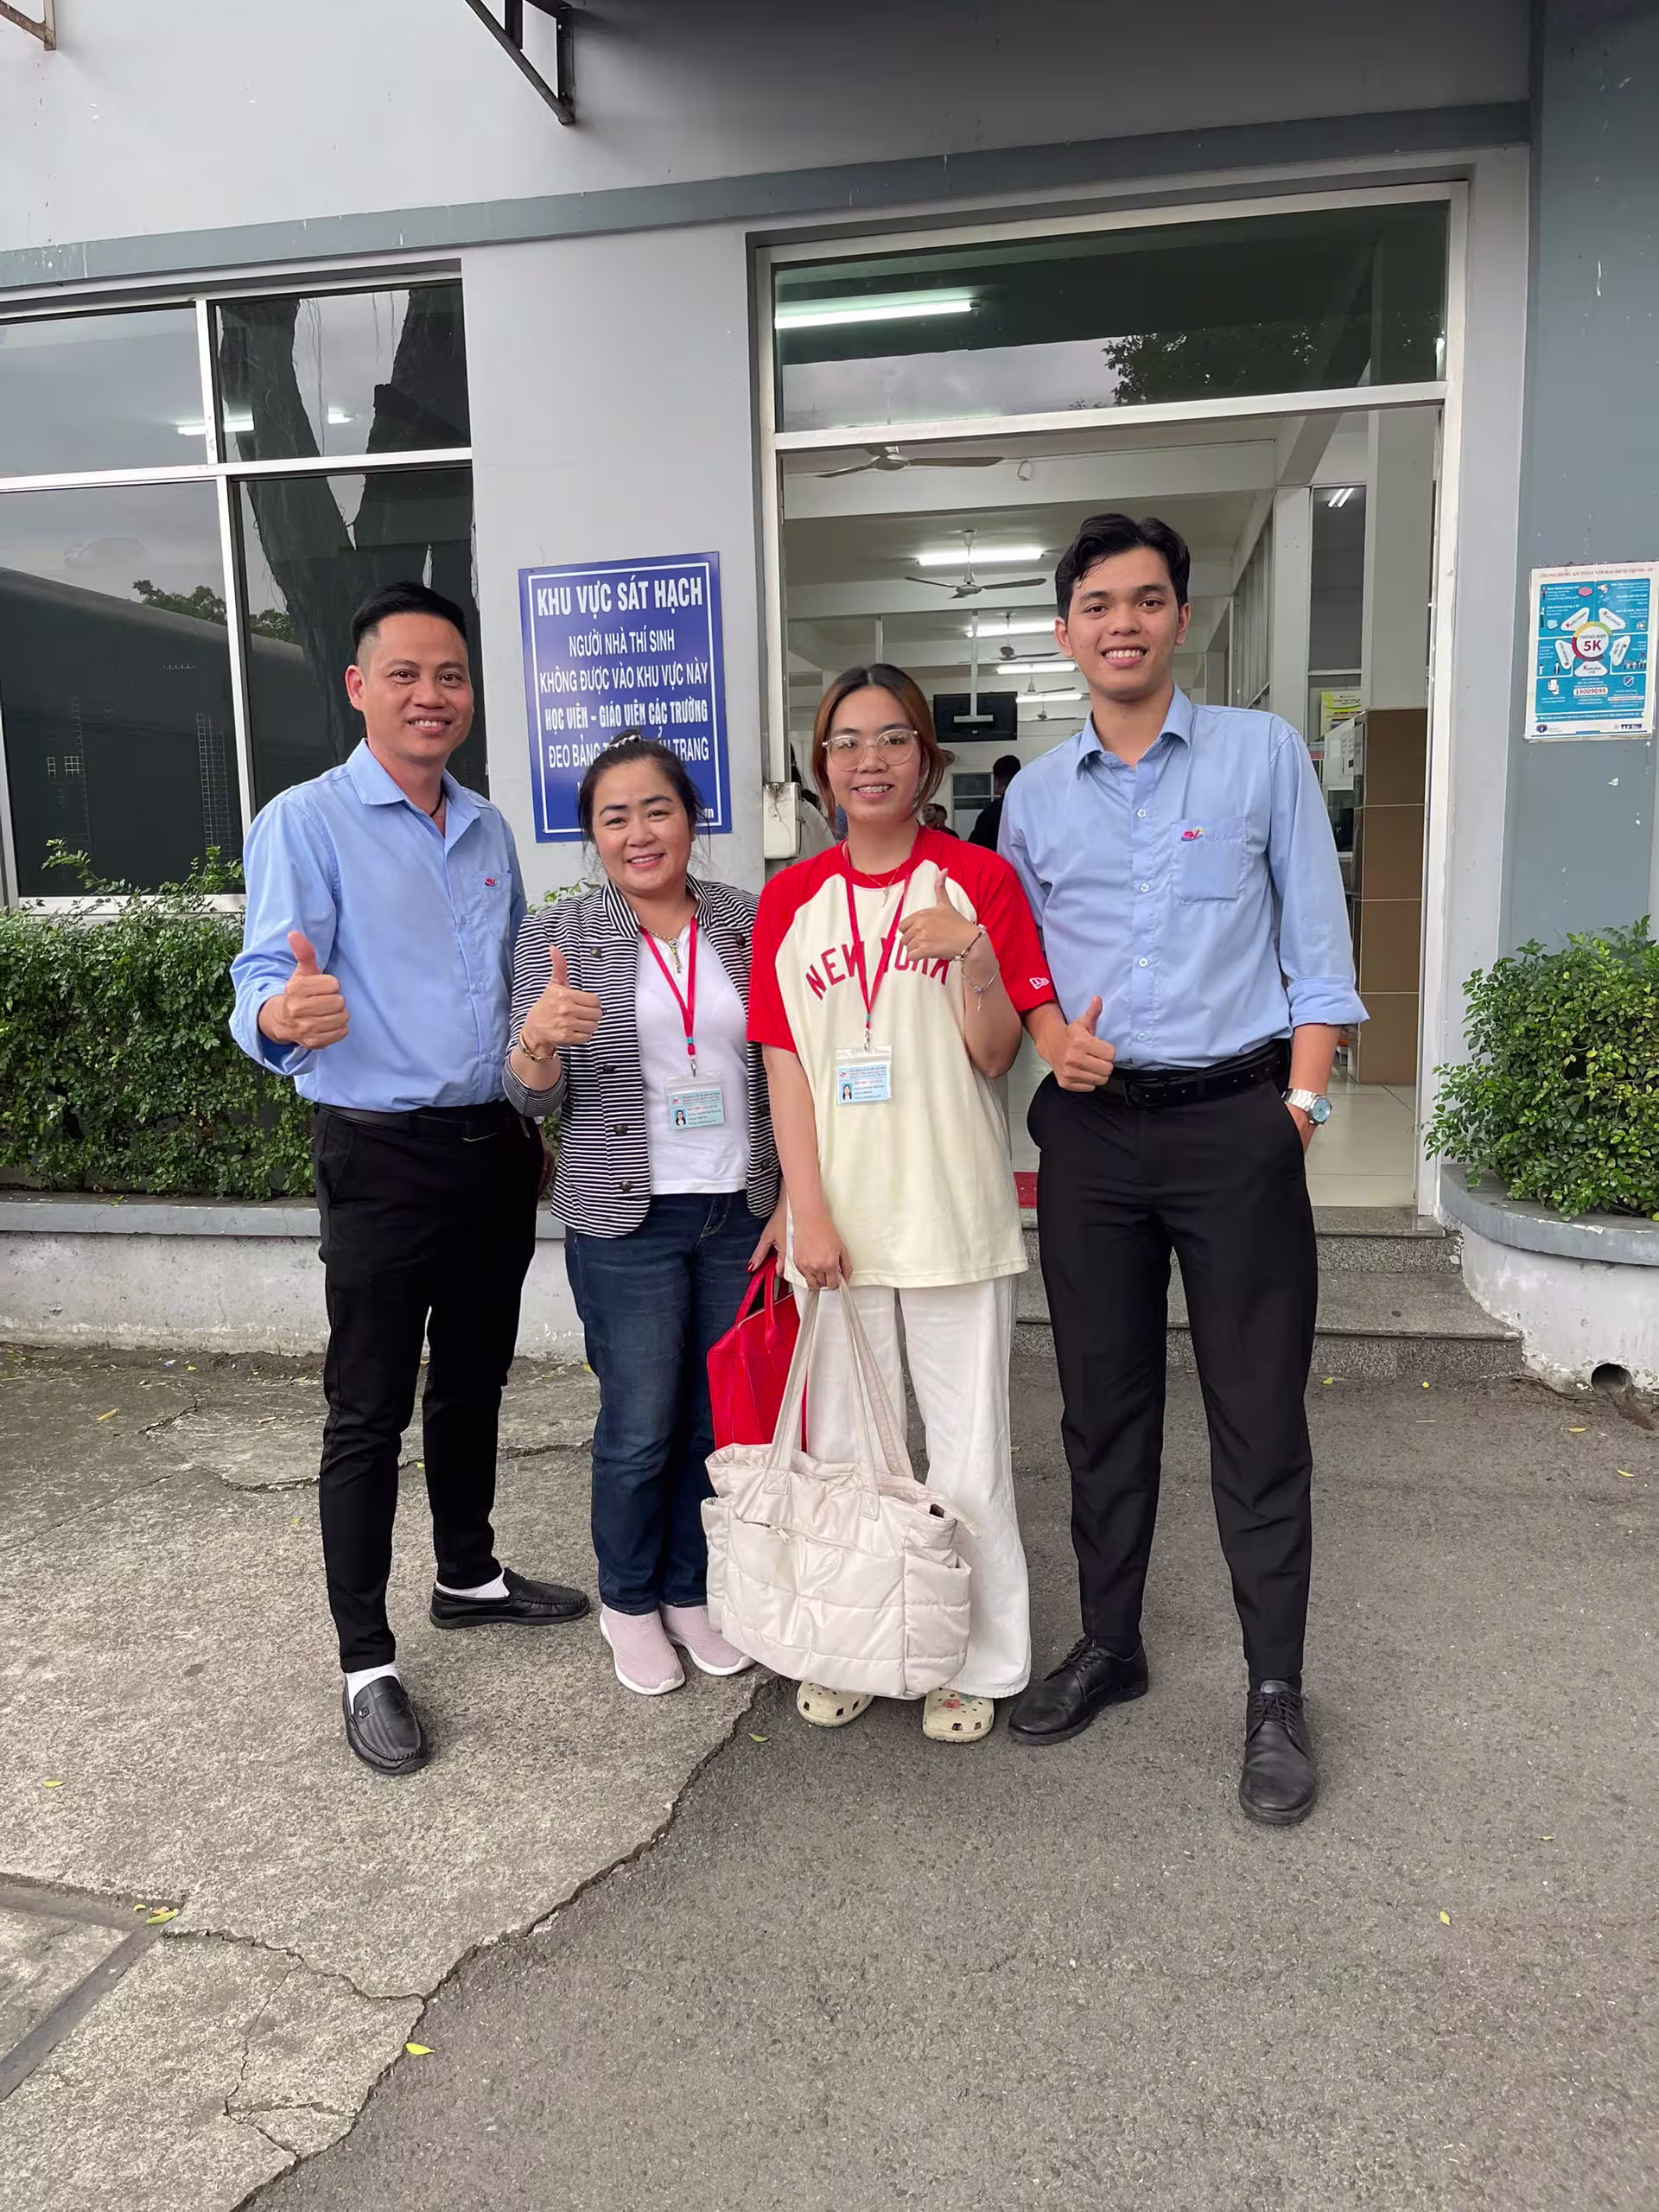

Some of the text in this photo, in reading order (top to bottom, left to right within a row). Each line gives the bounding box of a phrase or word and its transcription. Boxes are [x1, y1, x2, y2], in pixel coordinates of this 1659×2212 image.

[537, 575, 702, 619] KHU VỰC SÁT HẠCH
[569, 625, 675, 658] NGƯỜI NHÀ THÍ SINH
[1583, 639, 1602, 652] 5K
[539, 657, 708, 695] KHÔNG ĐƯỢC VÀO KHU VỰC NÀY
[545, 708, 564, 734] HỌC
[567, 703, 588, 729] VIÊN
[599, 701, 621, 728] GIÁO
[624, 699, 646, 727] VIÊN
[648, 697, 668, 725] CÁC
[670, 696, 708, 723] TRƯỜNG
[549, 744, 570, 768] ĐEO
[572, 734, 601, 767] BẢNG
[673, 736, 709, 761] TRANG
[805, 940, 865, 1001] NEW
